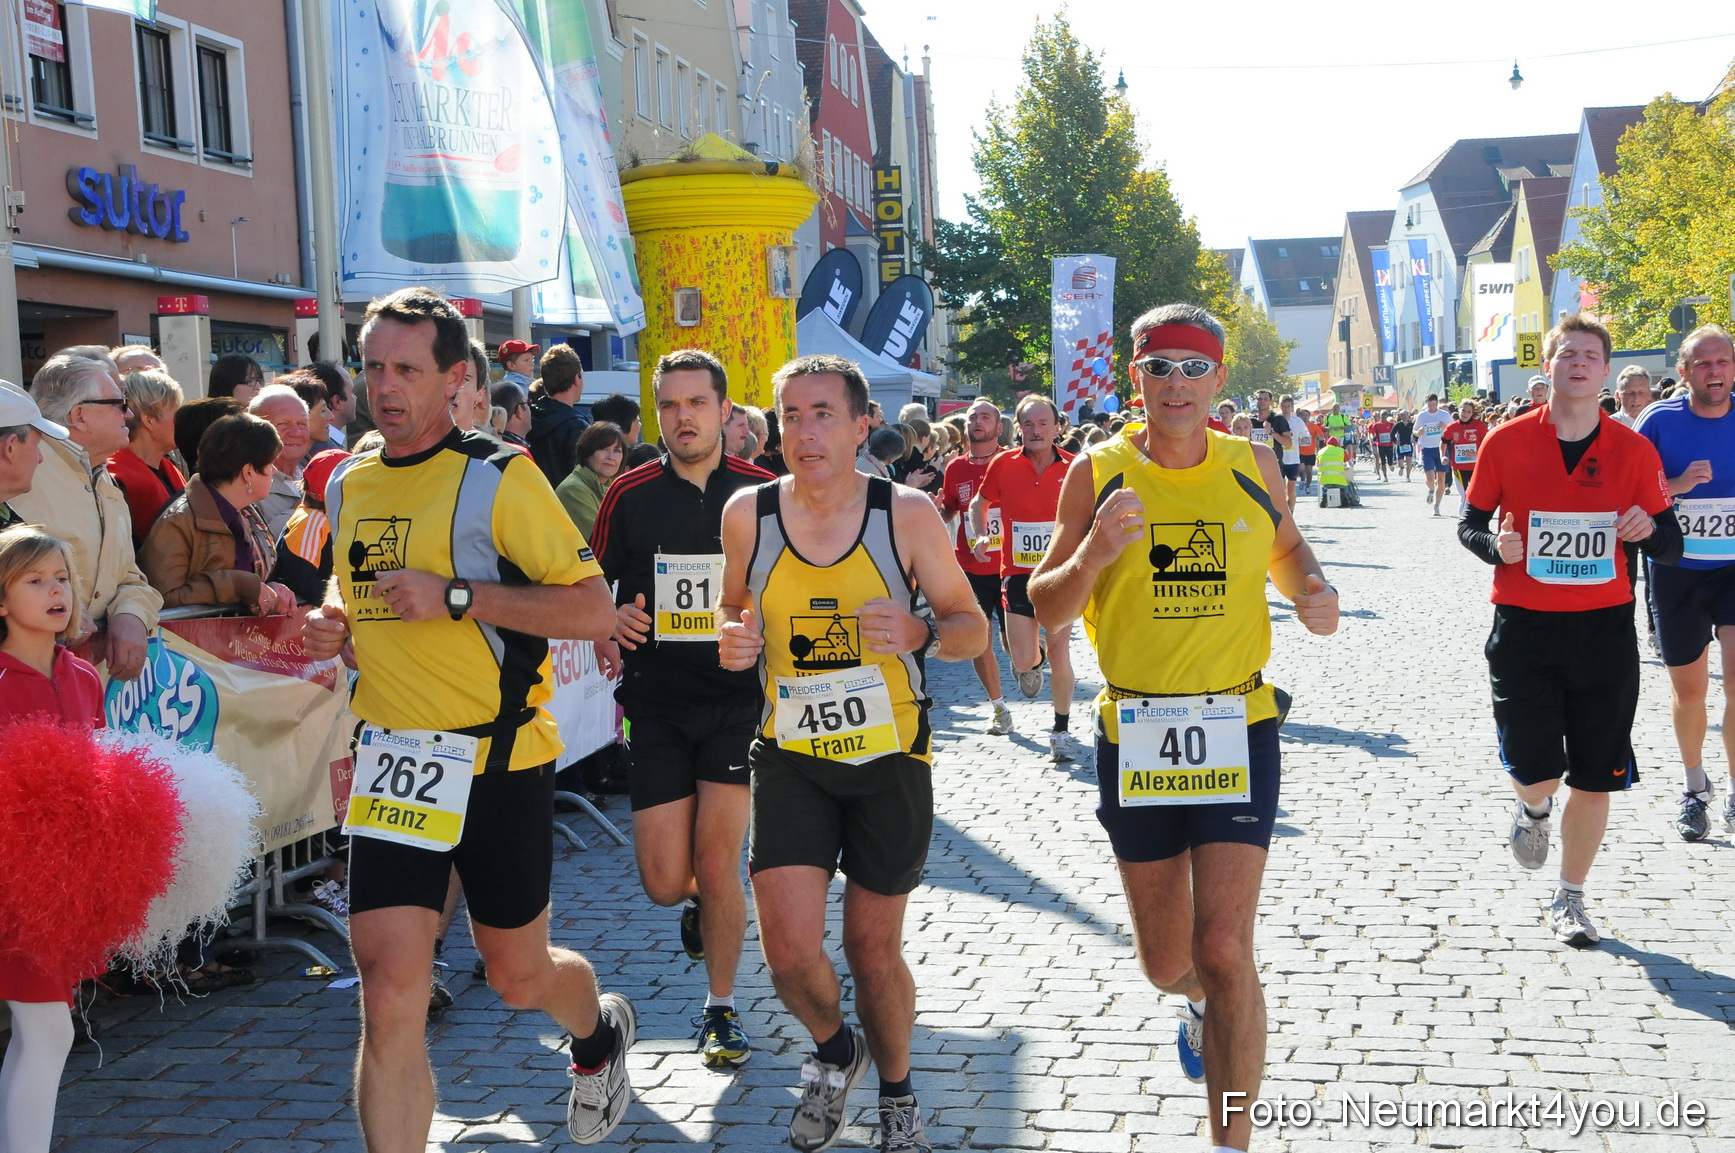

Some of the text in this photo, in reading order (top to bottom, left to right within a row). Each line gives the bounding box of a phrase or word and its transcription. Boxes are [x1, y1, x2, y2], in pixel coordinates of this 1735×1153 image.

[69, 163, 190, 243] sutor
[1062, 292, 1104, 301] SEAT
[1479, 282, 1514, 294] swn
[1523, 343, 1536, 361] B
[1255, 433, 1269, 442] 729
[1542, 518, 1581, 526] PFLEIDERER
[1678, 515, 1735, 538] 3428
[1023, 534, 1052, 552] 902
[1538, 531, 1606, 559] 2200
[668, 562, 711, 571] PFLEIDERER
[1546, 560, 1598, 578] Jürgen
[675, 578, 720, 610] 81
[1152, 584, 1227, 598] HIRSCH
[1153, 604, 1224, 613] APOTHEKE
[671, 612, 715, 630] Domi
[248, 625, 272, 653] Essige
[271, 641, 290, 655] und
[234, 639, 260, 664] Weine
[260, 652, 288, 670] frisch
[290, 661, 316, 674] vom
[789, 682, 832, 695] PFLEIDERER
[797, 696, 867, 734] 450
[1136, 707, 1189, 717] PFLEIDERER
[372, 730, 422, 749] PFLEIDERER
[810, 734, 867, 758] Franz
[1159, 725, 1207, 766] 40
[433, 744, 466, 756] BOCK
[337, 768, 352, 782] Der
[368, 752, 445, 804] 262
[1129, 769, 1240, 791] Alexander
[367, 798, 428, 831] Franz
[270, 821, 291, 842] 09181
